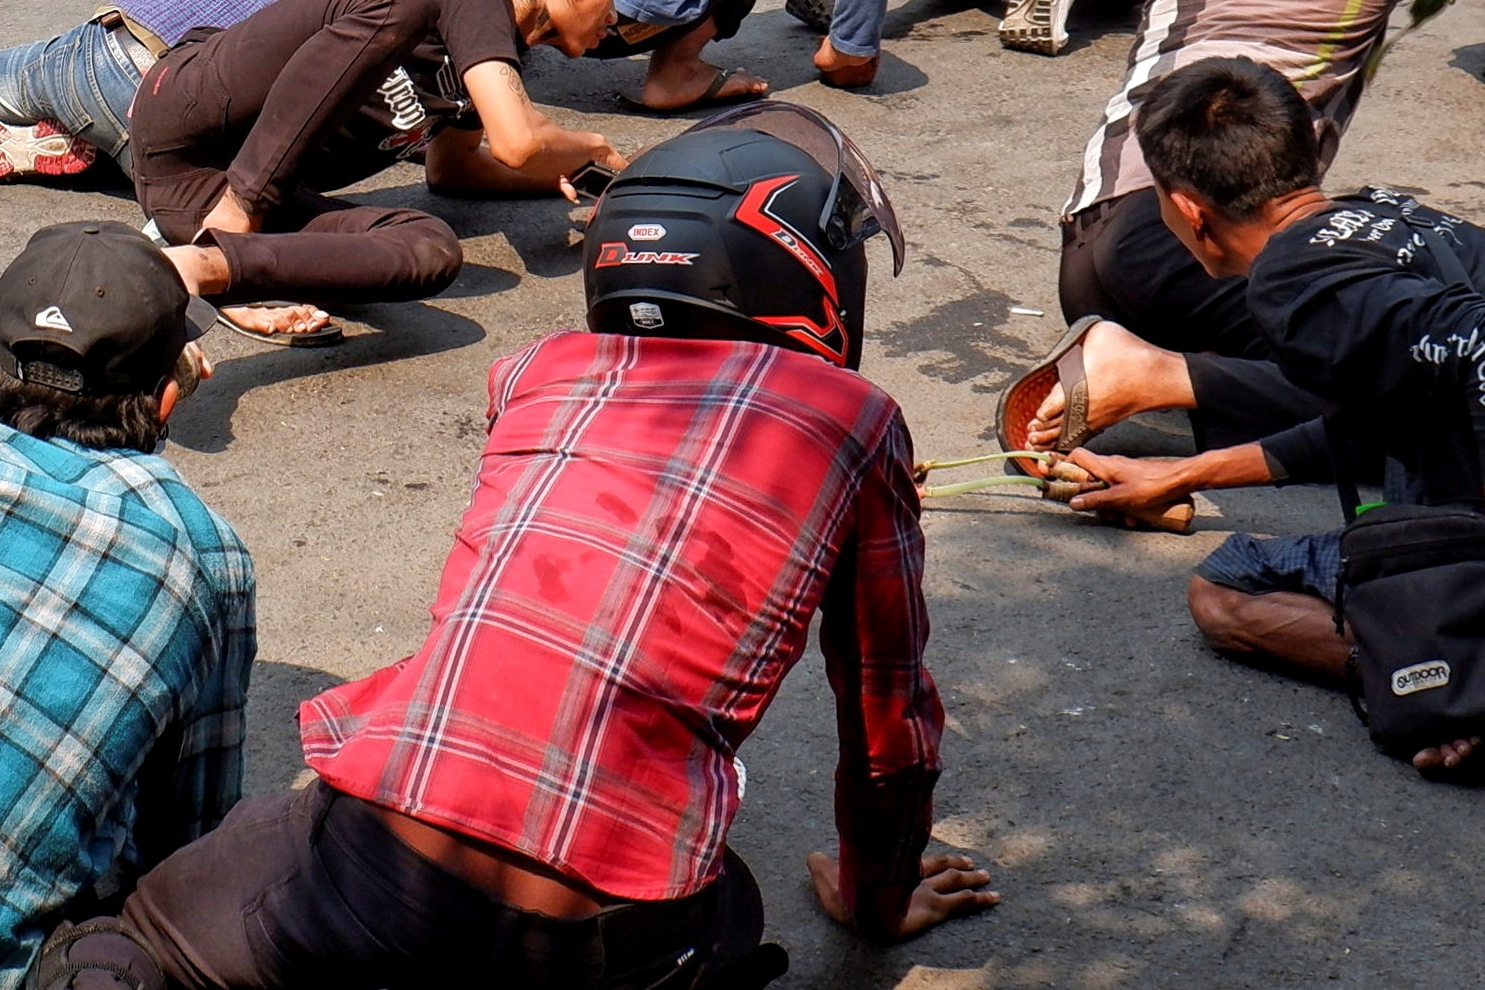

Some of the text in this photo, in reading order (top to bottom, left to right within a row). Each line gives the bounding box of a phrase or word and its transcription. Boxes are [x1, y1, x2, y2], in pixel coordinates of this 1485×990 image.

[632, 228, 660, 237] INDEX
[595, 242, 701, 268] DUNK
[1396, 666, 1448, 689] OUTDOOR
